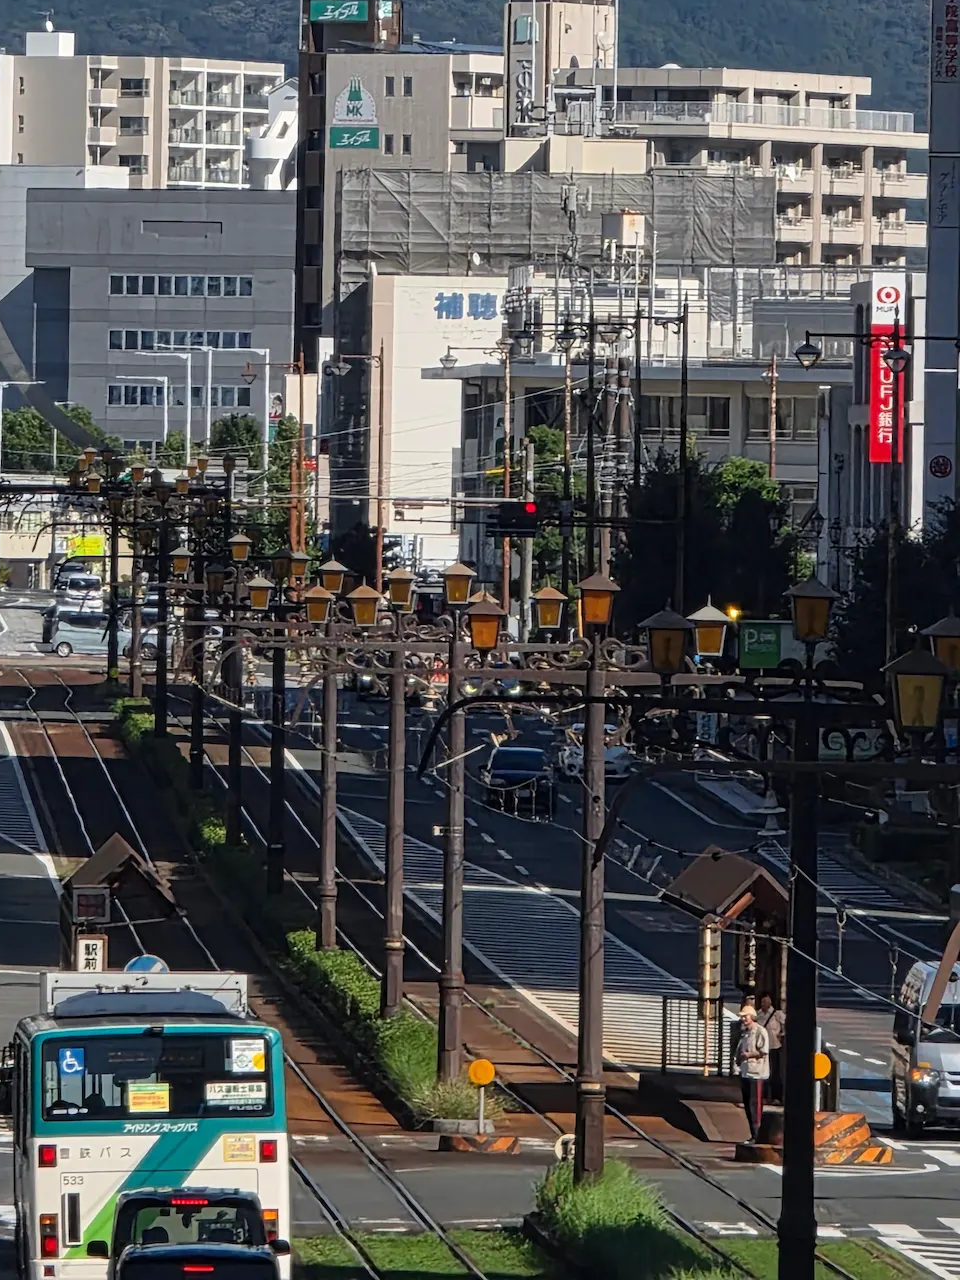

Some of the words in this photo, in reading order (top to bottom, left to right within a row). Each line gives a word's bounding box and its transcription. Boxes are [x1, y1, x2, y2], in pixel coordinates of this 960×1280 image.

[347, 104, 363, 117] MK
[433, 292, 508, 320] 補聴
[83, 943, 99, 970] 駅前
[62, 1175, 84, 1185] 533
